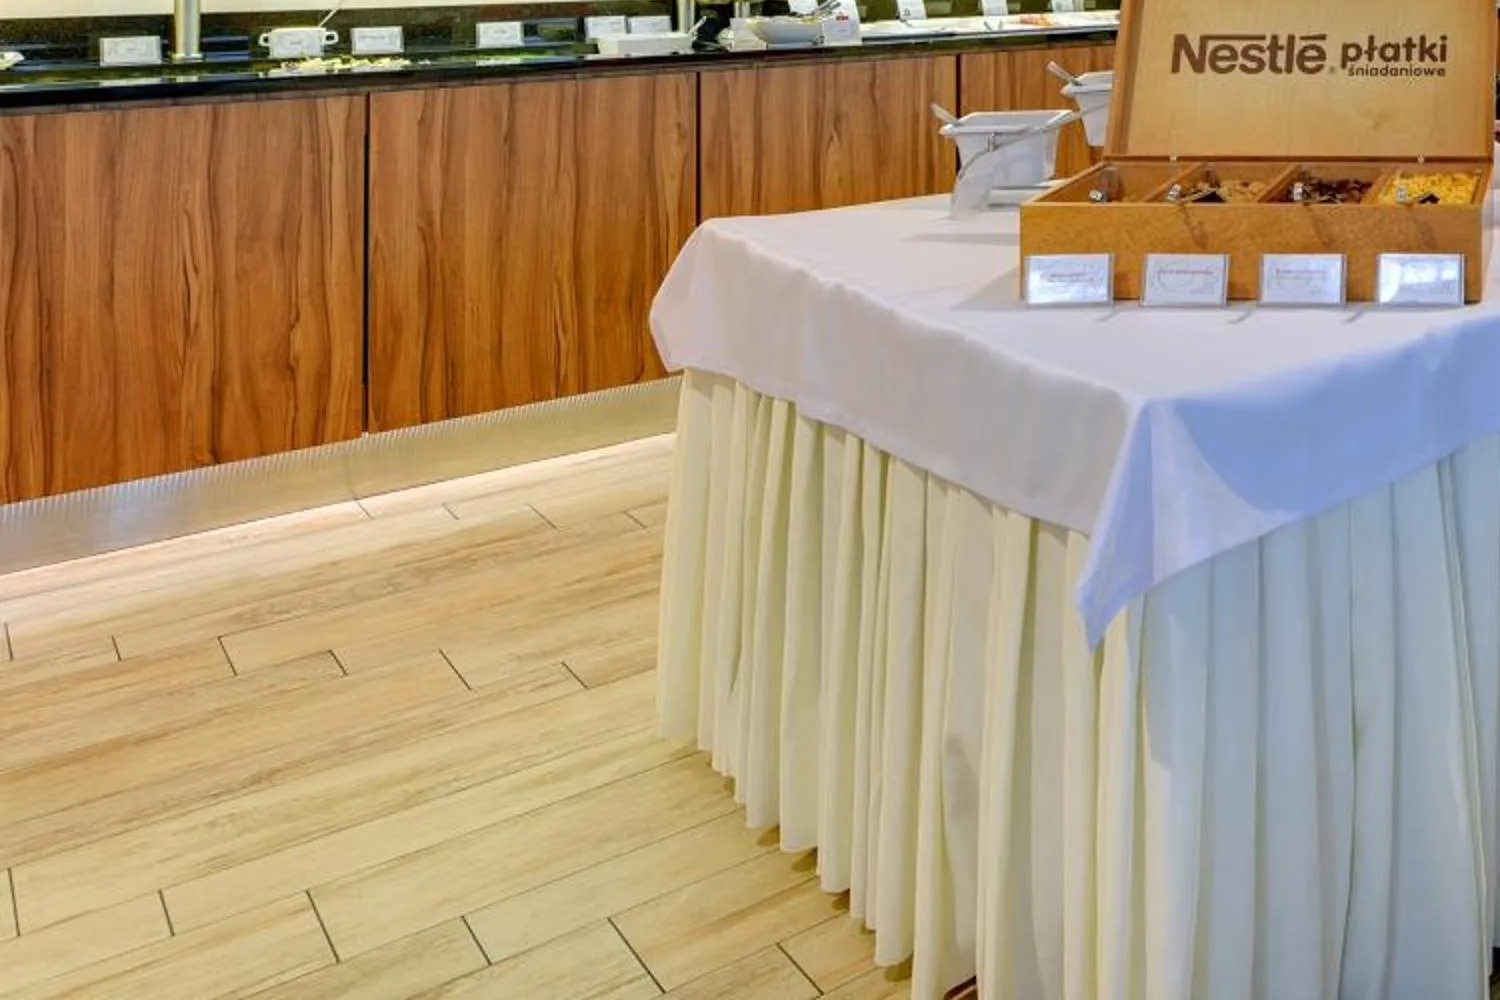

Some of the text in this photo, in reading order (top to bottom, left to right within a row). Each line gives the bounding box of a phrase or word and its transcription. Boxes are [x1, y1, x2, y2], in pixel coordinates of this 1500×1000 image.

[1171, 34, 1449, 75] Nestlé płatki
[1347, 62, 1447, 78] śniadaniowe
